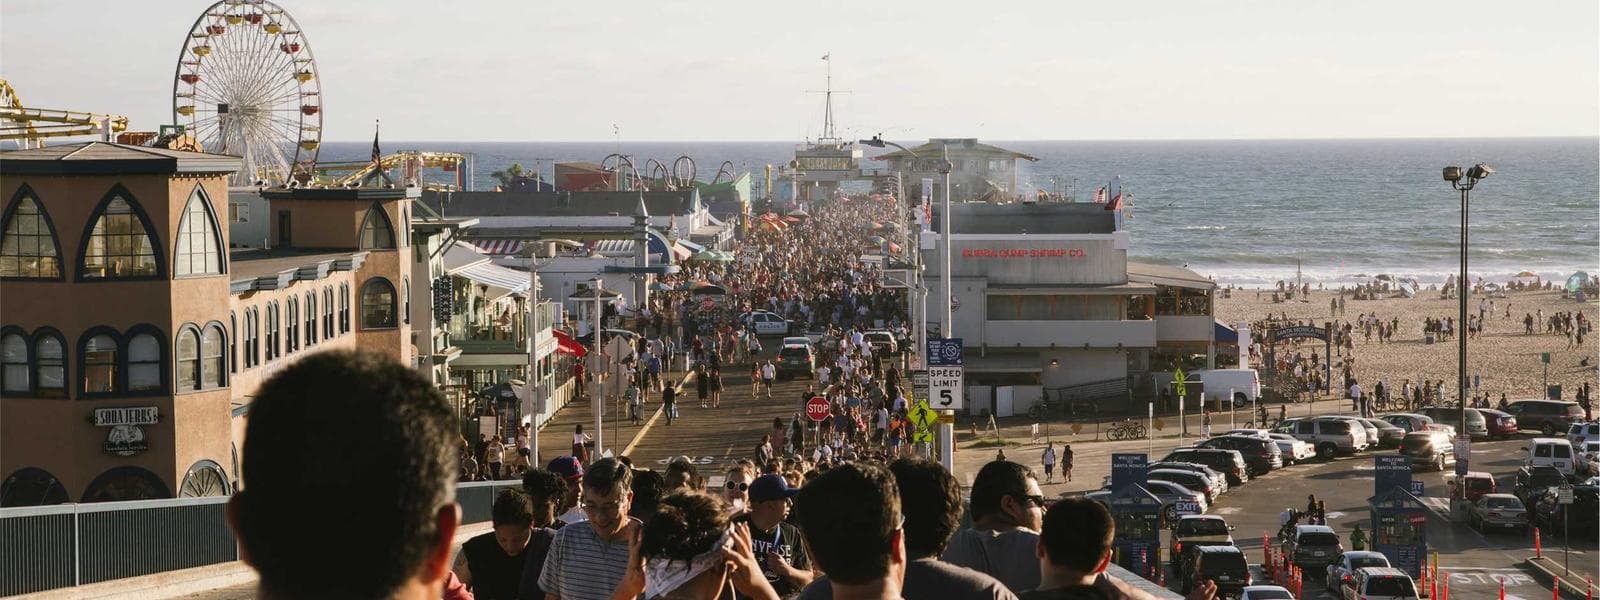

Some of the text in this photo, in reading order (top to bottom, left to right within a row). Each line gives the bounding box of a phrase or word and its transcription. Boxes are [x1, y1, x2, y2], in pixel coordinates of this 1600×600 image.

[930, 369, 961, 377] SPEED
[940, 389, 953, 406] 5
[808, 403, 829, 414] STOP
[100, 408, 152, 424] SODA JERKS
[1175, 502, 1198, 511] EXIT
[751, 539, 791, 557] NVESE
[1450, 573, 1536, 585] STOP
